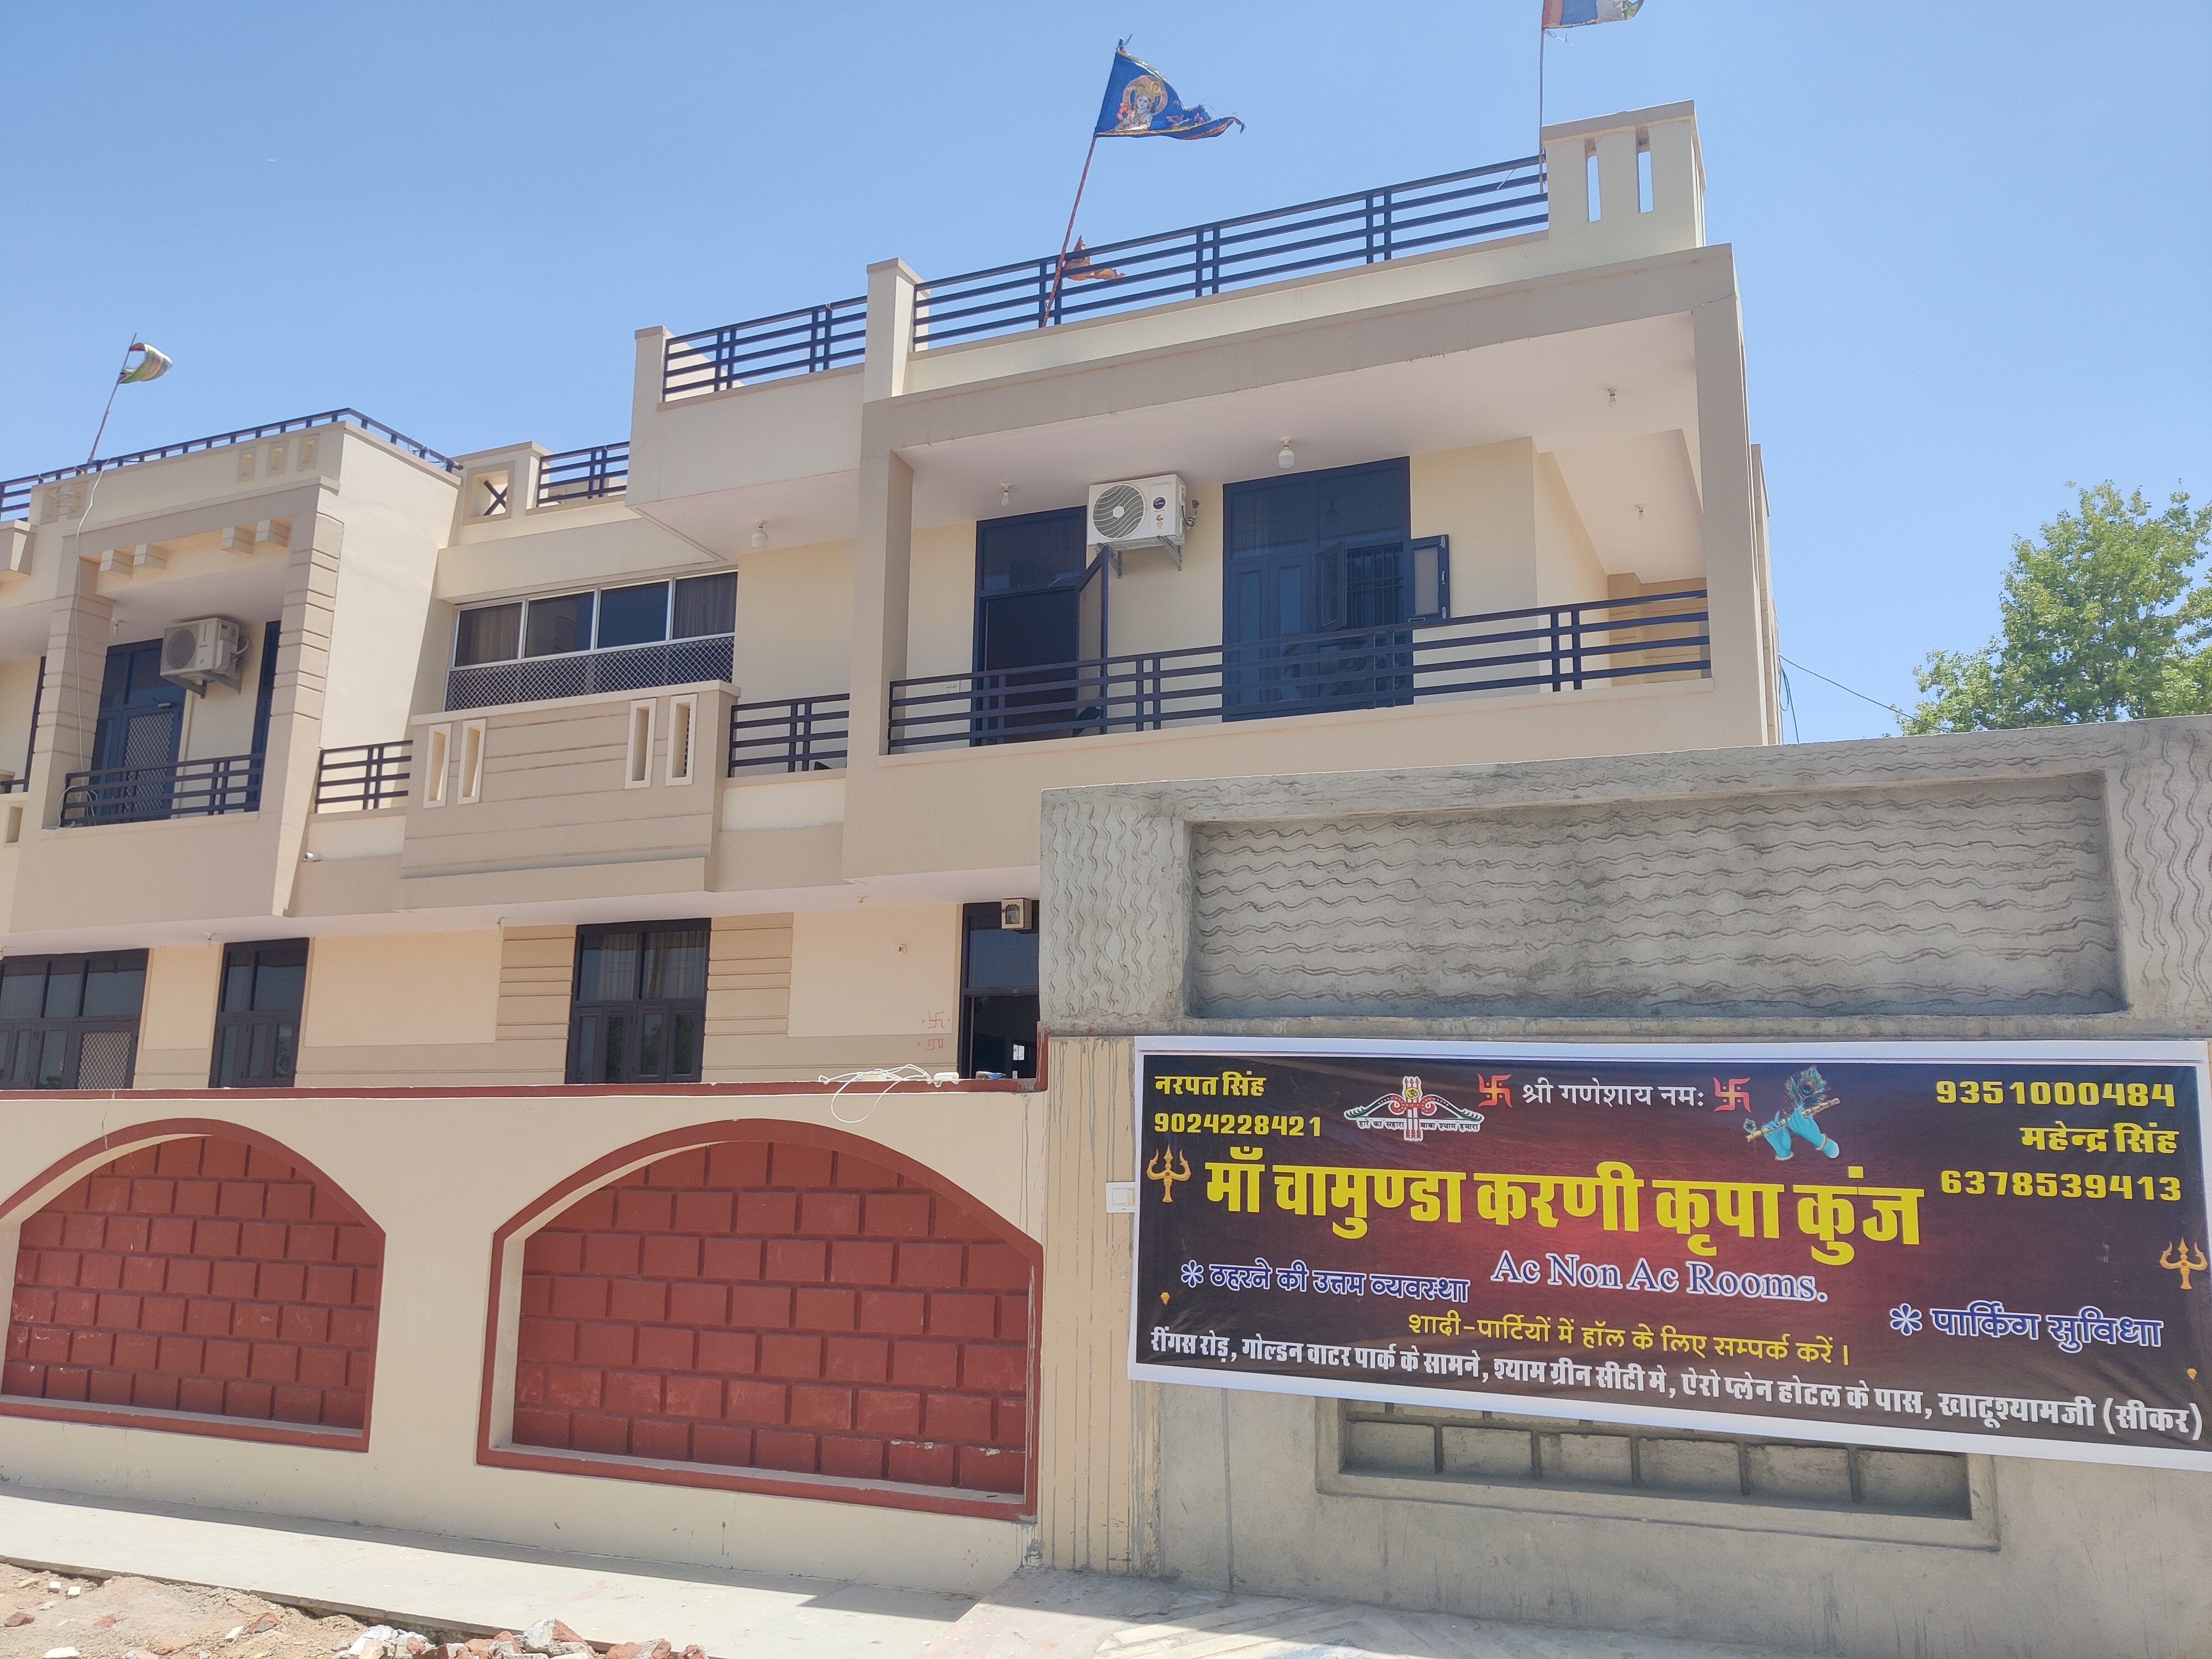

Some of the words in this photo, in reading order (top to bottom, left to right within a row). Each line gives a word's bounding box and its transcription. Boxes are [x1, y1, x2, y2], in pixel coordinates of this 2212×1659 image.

[1155, 1074, 1219, 1096] नरपत
[1222, 1071, 1266, 1097] सिंह
[1522, 1077, 1554, 1105] श्री
[1558, 1077, 1654, 1107] गणेशाय
[1658, 1085, 1705, 1107] नमः
[1936, 1081, 2175, 1107] 9351000484
[1154, 1113, 1321, 1137] 9024228421
[2020, 1120, 2109, 1153] महेन्द्र
[2114, 1122, 2179, 1154] सिंह
[1941, 1170, 2181, 1201] 6378539413
[1272, 1165, 1467, 1239] चामुण्डा
[1474, 1161, 1644, 1233] करणी
[1652, 1179, 1785, 1256] कृपा
[1793, 1166, 1924, 1265] कुंज
[1209, 1258, 1272, 1292] ठहरने
[1275, 1259, 1309, 1292] की
[1312, 1270, 1368, 1296] उत्तम
[1370, 1274, 1470, 1304] व्यवस्था
[1490, 1249, 1541, 1285] Ac
[1546, 1252, 1623, 1290] Non
[1627, 1258, 1679, 1292] Ac
[1686, 1260, 1828, 1302] Rooms.
[1557, 1317, 1575, 1344] में
[1581, 1321, 1626, 1349] हॉल
[1631, 1323, 1655, 1350] के
[1660, 1325, 1707, 1359] लिए
[1713, 1333, 1792, 1361] सम्पर्क
[1795, 1335, 1834, 1364] करें
[1930, 1300, 2041, 1340] पार्किंग
[2046, 1306, 2164, 1353] सुविधा
[1150, 1326, 1197, 1354] रींगस
[1241, 1333, 1304, 1363] गोल्डन
[1306, 1343, 1350, 1367] वाटर
[1354, 1343, 1397, 1371] पार्क
[1399, 1344, 1420, 1372] के
[1423, 1350, 1490, 1383] सामने,
[1494, 1358, 1547, 1383] श्याम
[1550, 1357, 1592, 1387] ग्रीन
[1595, 1361, 1645, 1392] सीटी
[1648, 1365, 1676, 1399] मे,
[1681, 1367, 1720, 1397] ऐरो
[1725, 1371, 1773, 1402] प्लेन
[1777, 1375, 1841, 1407] होटल
[1846, 1380, 1869, 1410] के
[1874, 1386, 1933, 1421] पास,
[2103, 1396, 2203, 1441] (सीकर)
